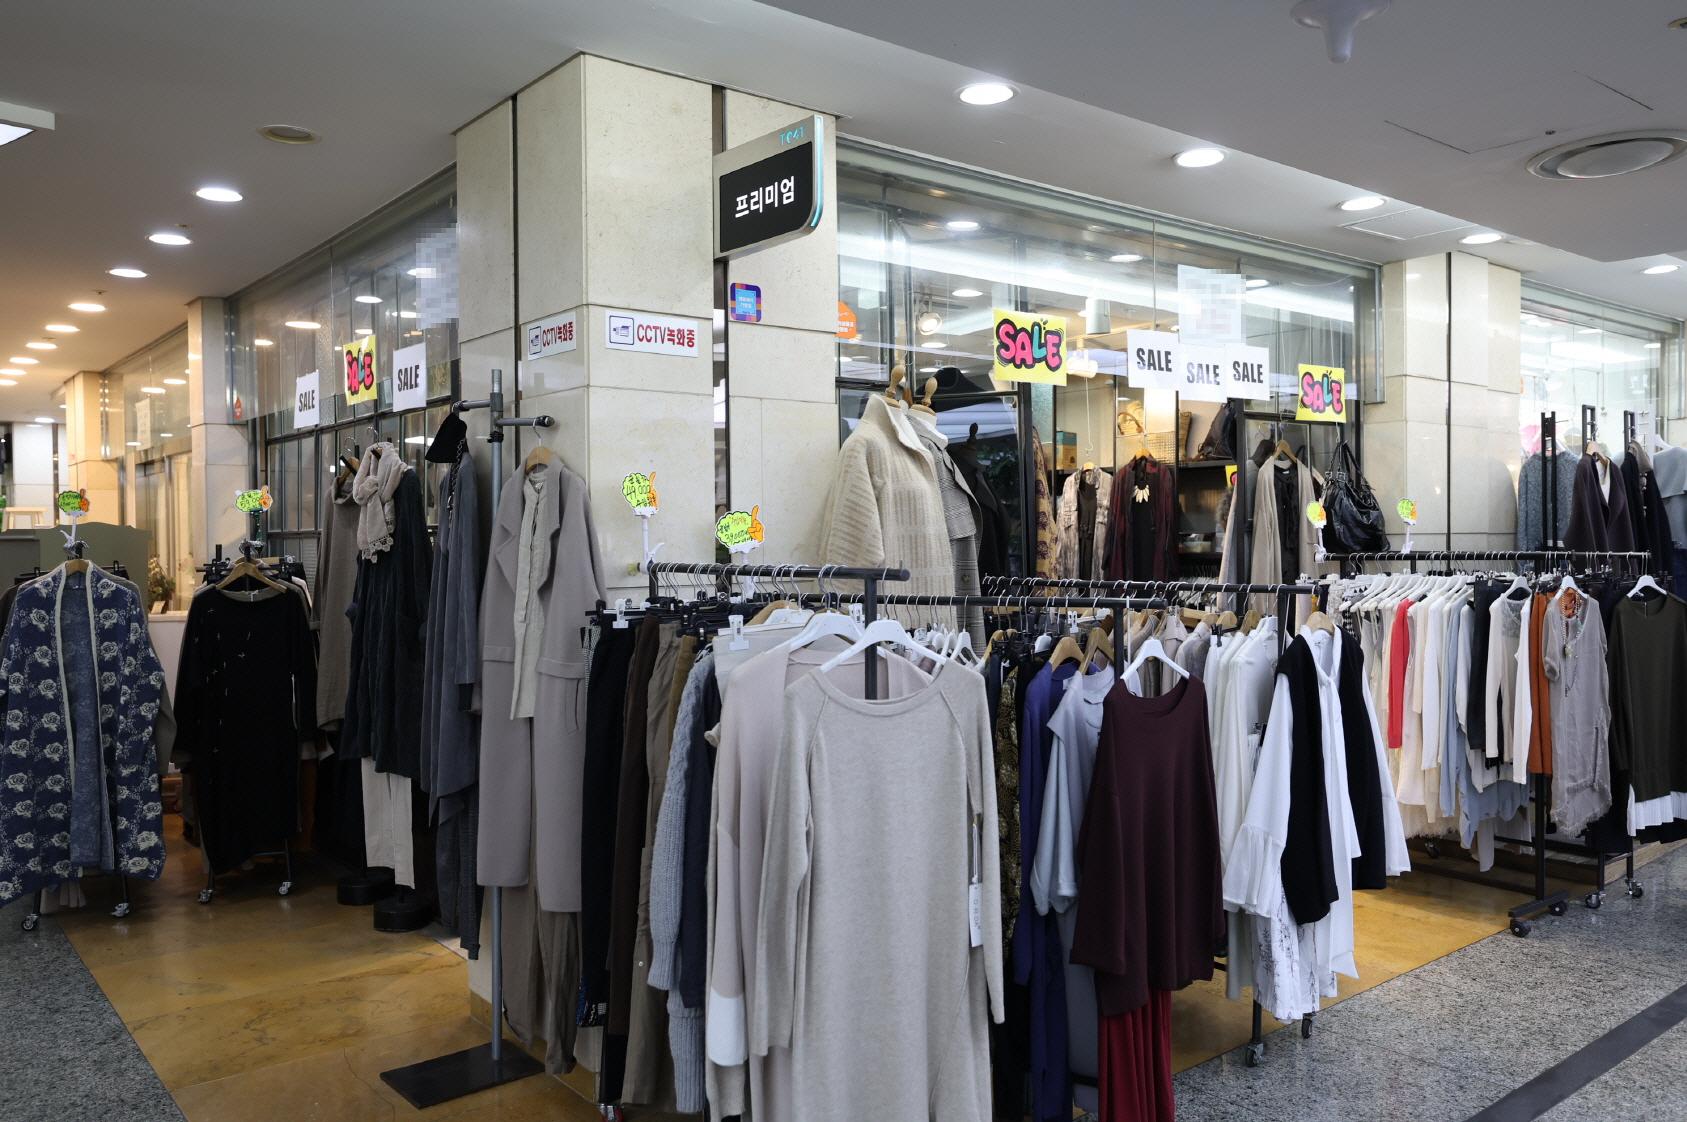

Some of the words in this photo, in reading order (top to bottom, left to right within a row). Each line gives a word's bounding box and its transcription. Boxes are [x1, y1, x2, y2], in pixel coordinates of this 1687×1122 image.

[735, 175, 795, 218] 프리미엄
[541, 321, 574, 348] CCTV녹화중
[636, 323, 696, 348] CCTV녹화중
[995, 318, 1063, 372] SALE
[345, 349, 374, 396] SALE
[1136, 347, 1173, 373] SALE
[1186, 361, 1221, 386] SALE
[1232, 360, 1264, 384] SALE
[397, 364, 420, 393] SALE
[298, 389, 316, 413] SALE
[1301, 371, 1343, 414] SALE
